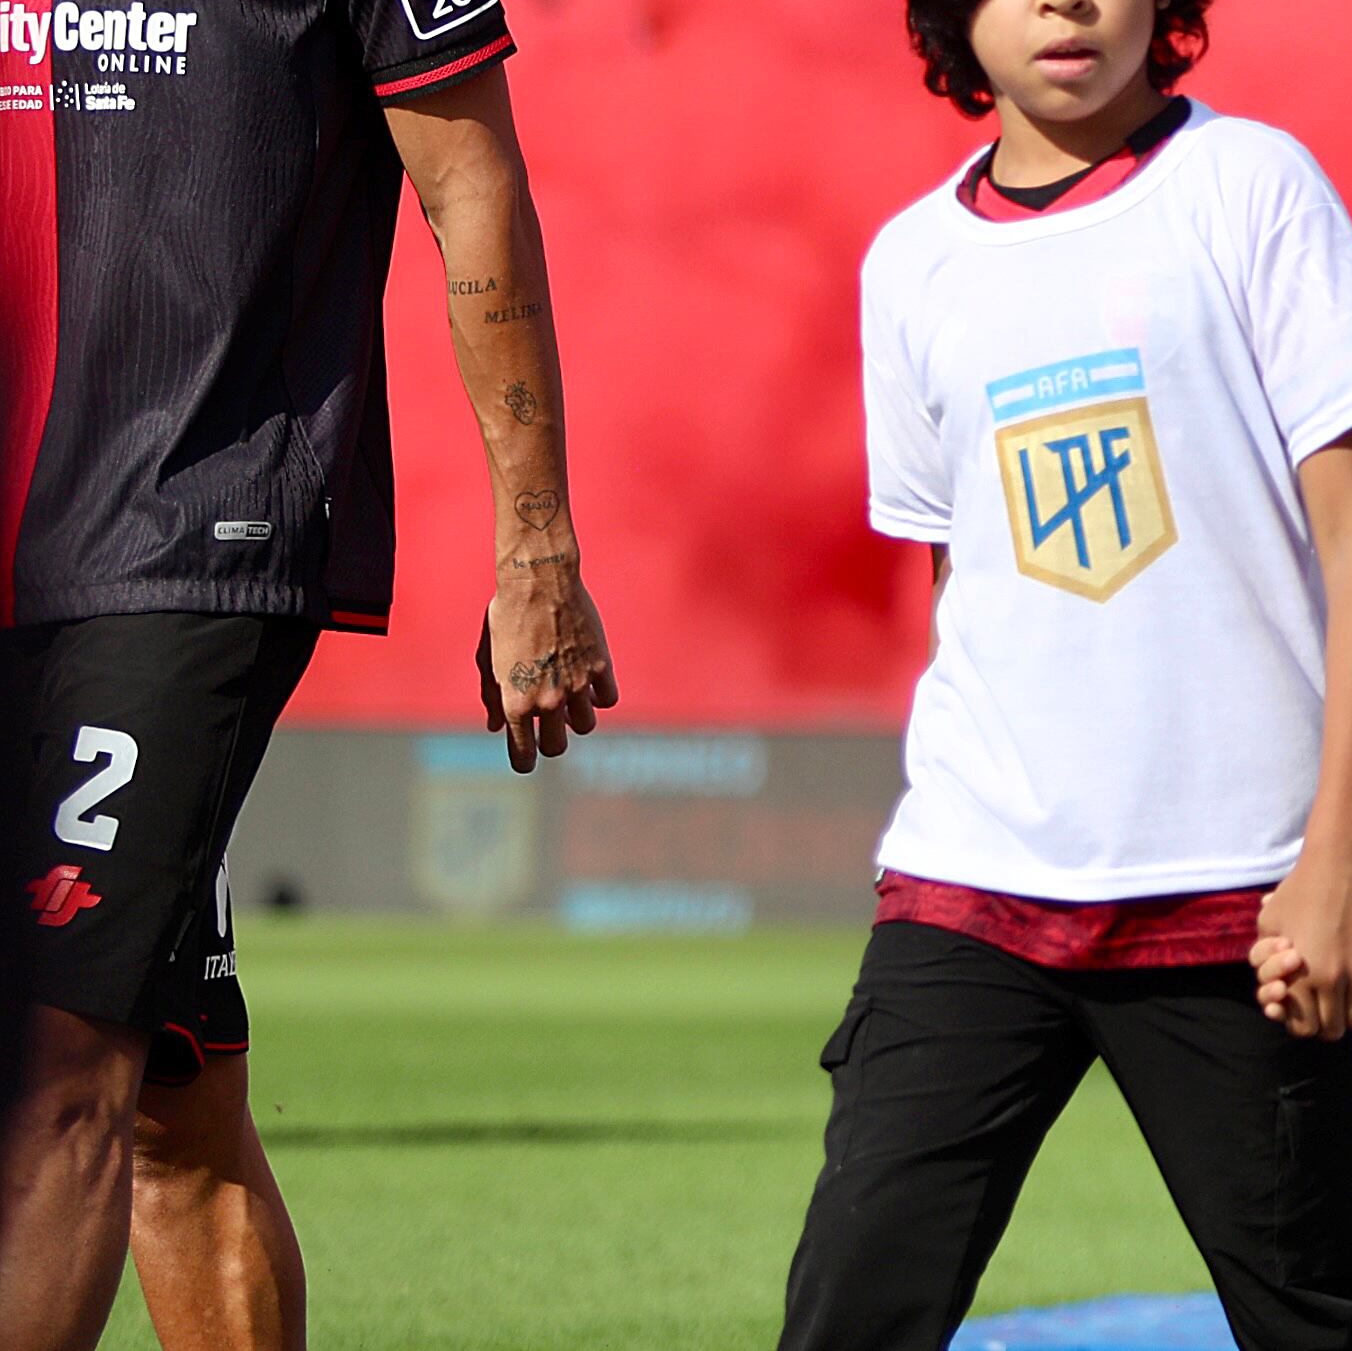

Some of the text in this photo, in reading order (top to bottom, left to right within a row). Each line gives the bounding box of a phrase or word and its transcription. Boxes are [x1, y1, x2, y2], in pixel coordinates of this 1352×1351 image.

[0, 0, 197, 65] ityCenter
[97, 52, 187, 75] ONLINE
[12, 85, 43, 96] PARA
[12, 99, 43, 110] EDAD
[117, 95, 136, 110] Fe
[1038, 367, 1089, 401] AFA
[1018, 426, 1131, 570] LPF
[54, 725, 139, 851] 2
